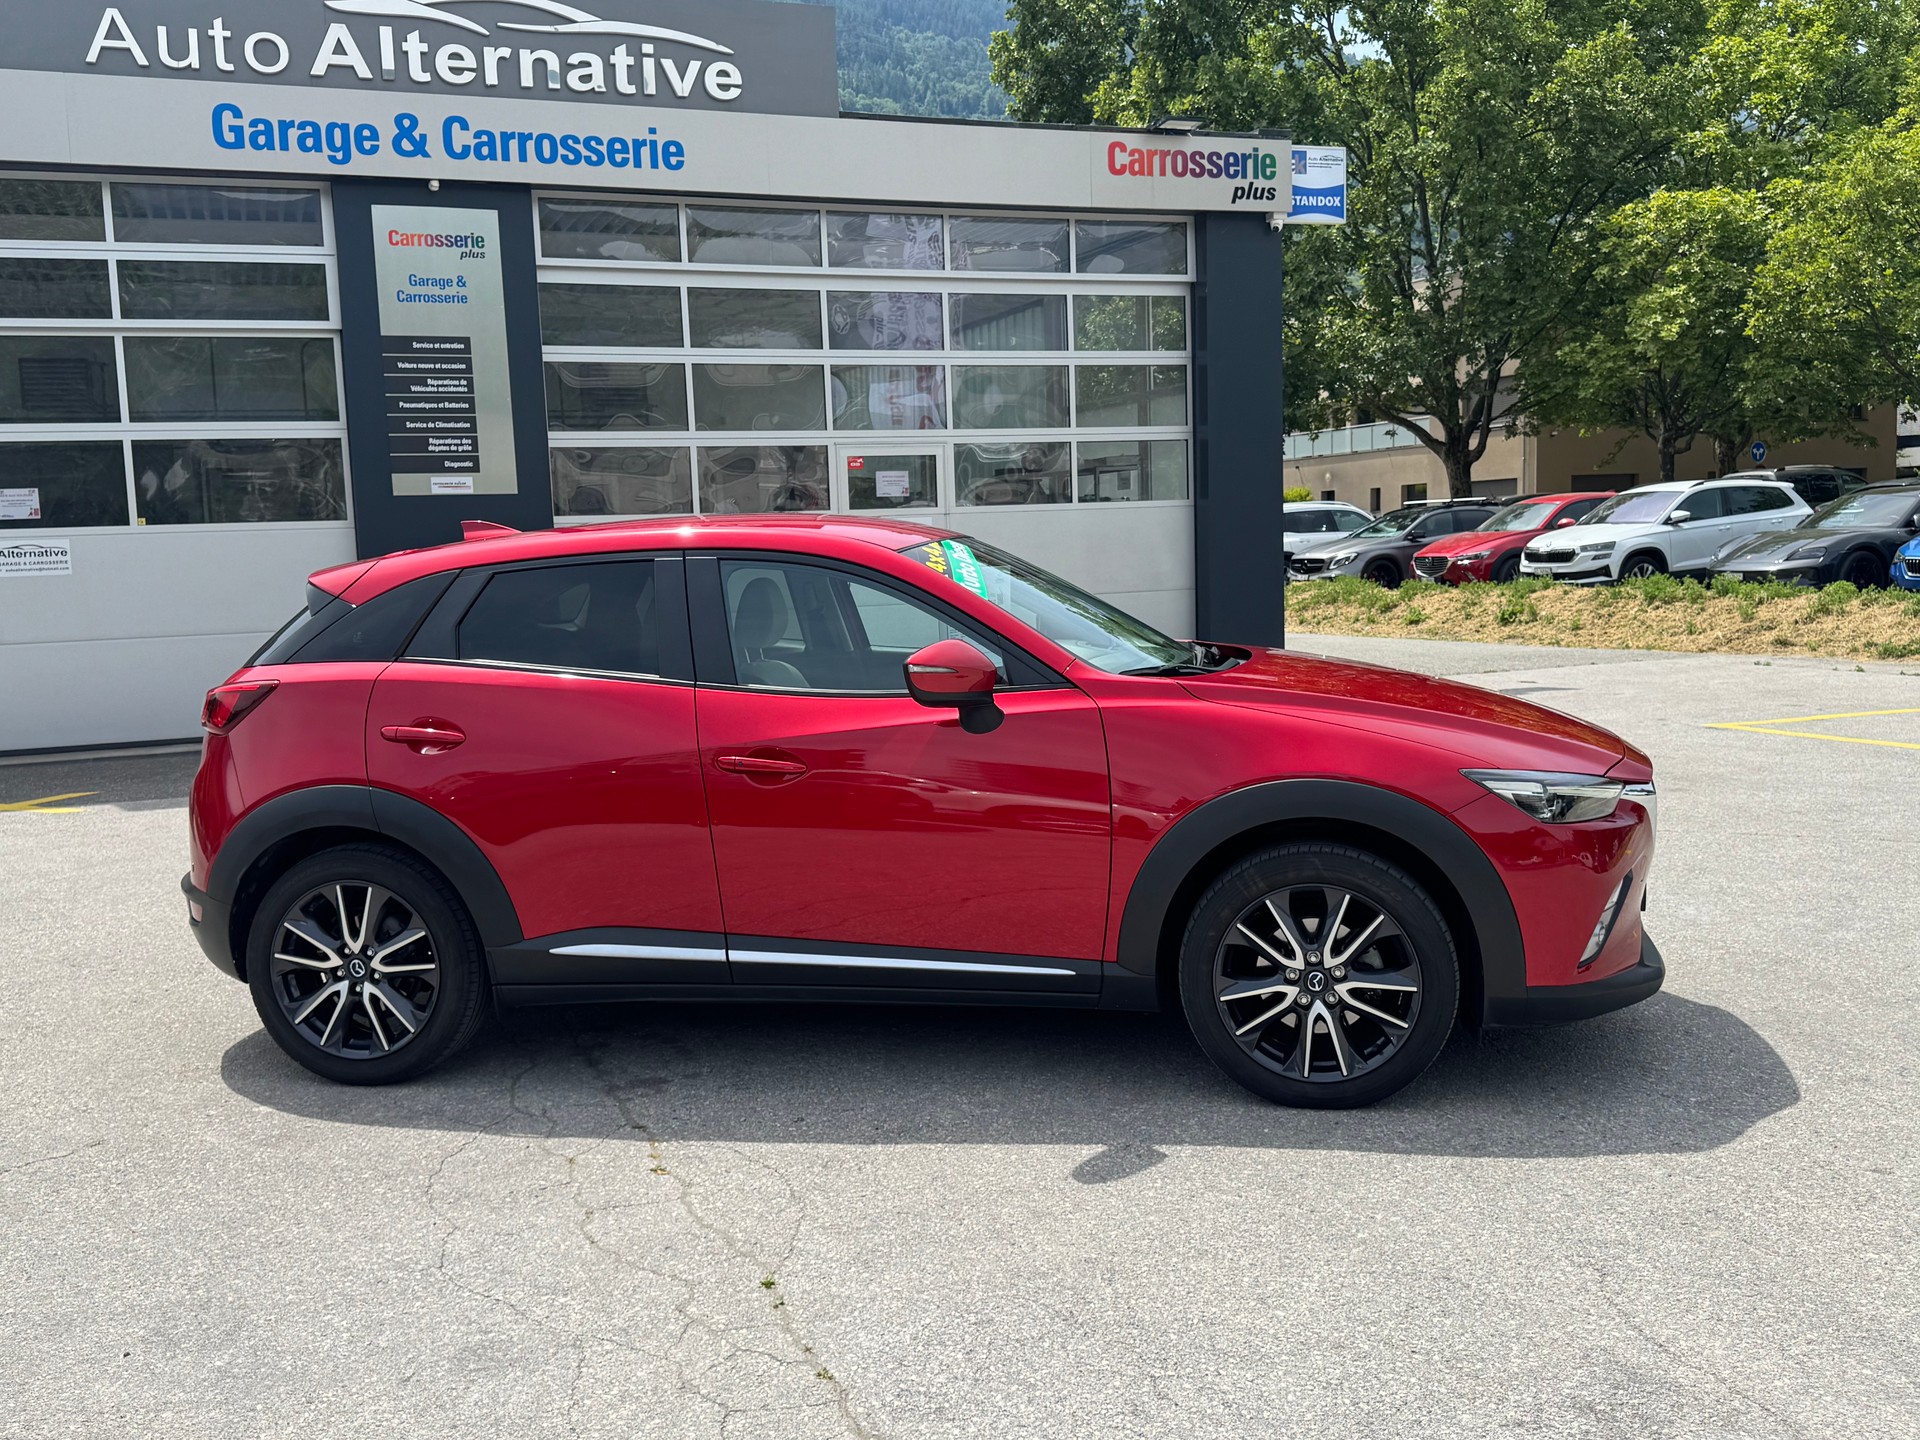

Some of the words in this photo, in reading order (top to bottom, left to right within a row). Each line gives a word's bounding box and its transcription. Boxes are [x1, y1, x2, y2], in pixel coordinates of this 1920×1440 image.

[85, 7, 290, 75] Auto
[310, 22, 743, 100] Alternative
[211, 102, 380, 165] Garage
[392, 112, 432, 158] &
[442, 115, 685, 171] Carrosserie
[1107, 140, 1277, 181] Carrosserie
[1231, 181, 1277, 204] plus
[388, 229, 485, 249] Carrosserie
[460, 249, 486, 260] plus
[408, 273, 453, 290] Garage
[456, 275, 467, 288] &
[396, 290, 468, 304] Carrosserie
[412, 341, 433, 349] Service
[397, 361, 417, 369] Voiture
[427, 378, 459, 386] Réparations
[399, 401, 437, 409] Pneumatiques
[444, 401, 469, 409] Batteries
[428, 437, 461, 445] Réparations
[461, 437, 472, 445] des
[444, 460, 474, 468] Diagnostic
